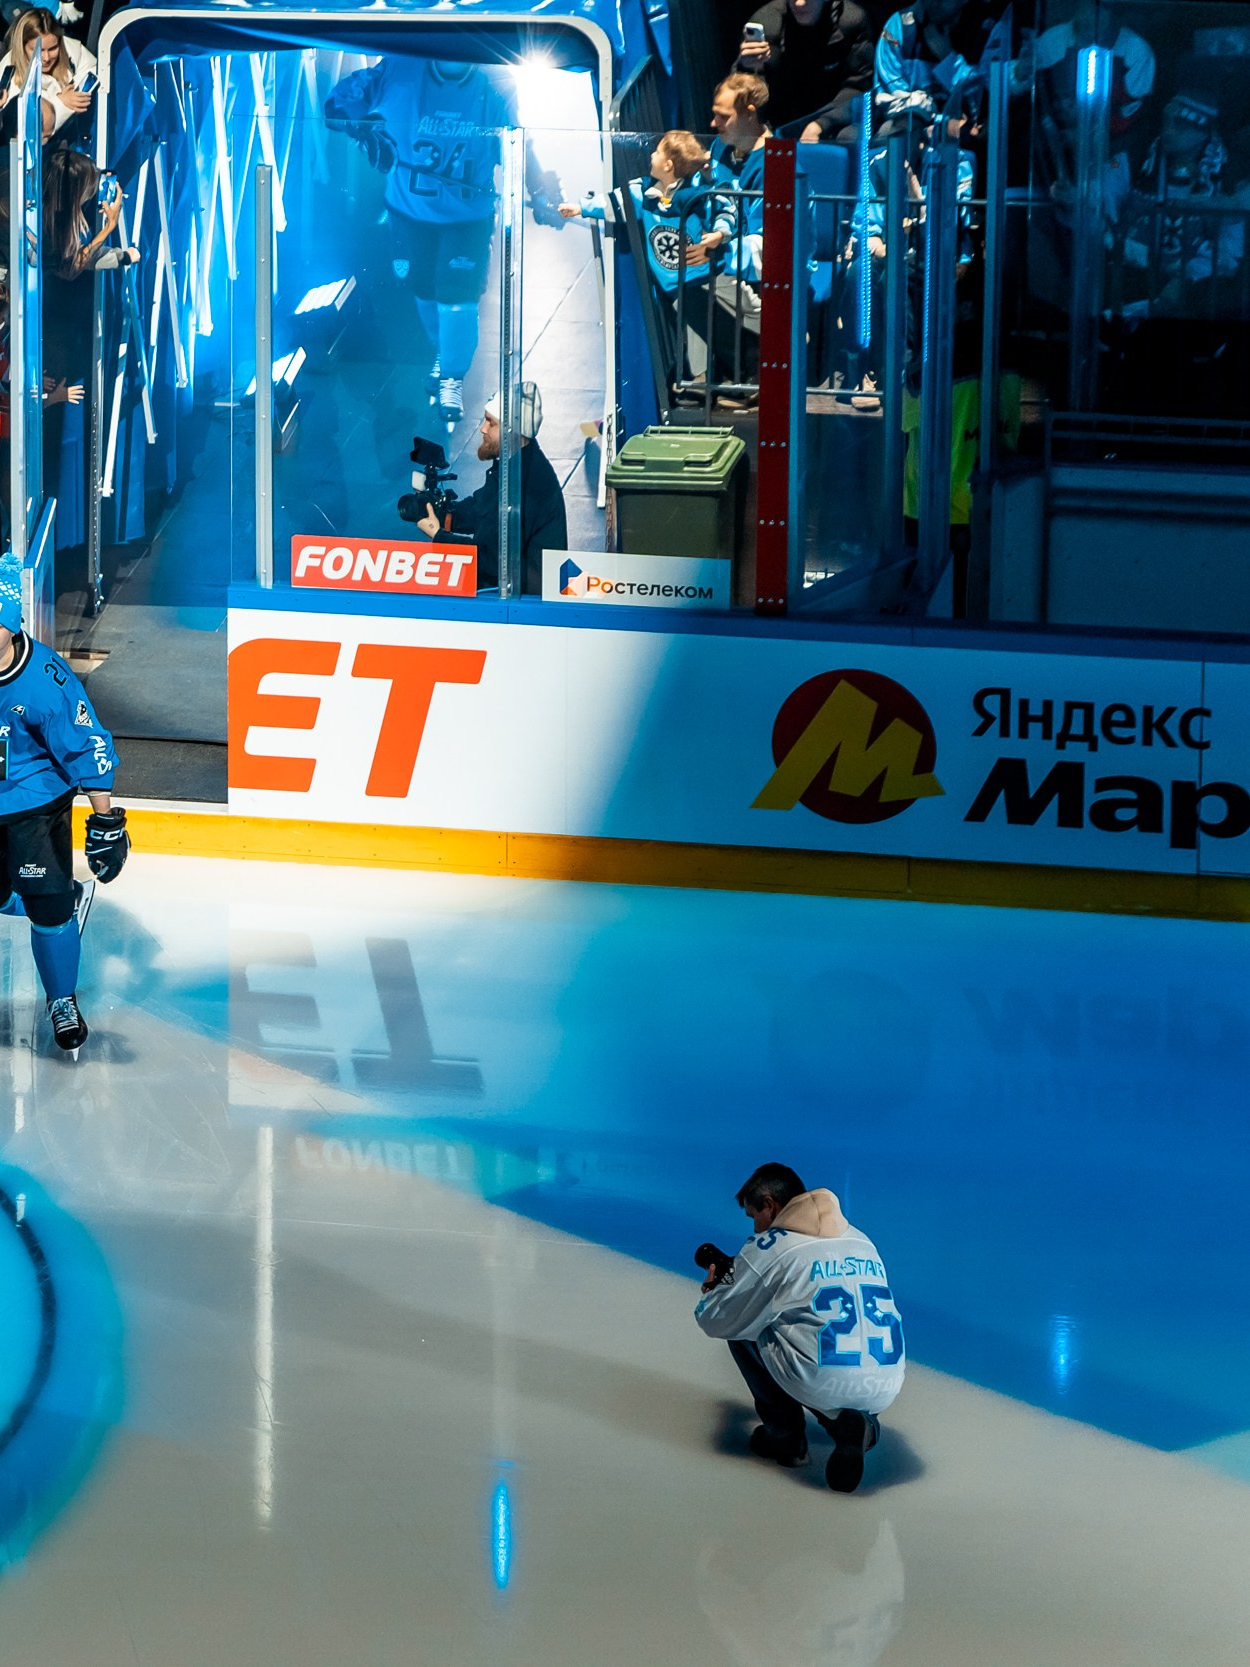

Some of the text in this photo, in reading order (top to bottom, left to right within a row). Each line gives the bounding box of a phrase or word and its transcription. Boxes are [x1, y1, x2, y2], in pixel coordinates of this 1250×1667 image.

[409, 138, 475, 199] 24
[295, 545, 473, 587] FONBET
[587, 576, 713, 599] Ростелеком
[228, 638, 487, 798] ET
[971, 687, 1213, 752] Яндекс
[963, 757, 1250, 850] Мар
[812, 1283, 906, 1368] 25
